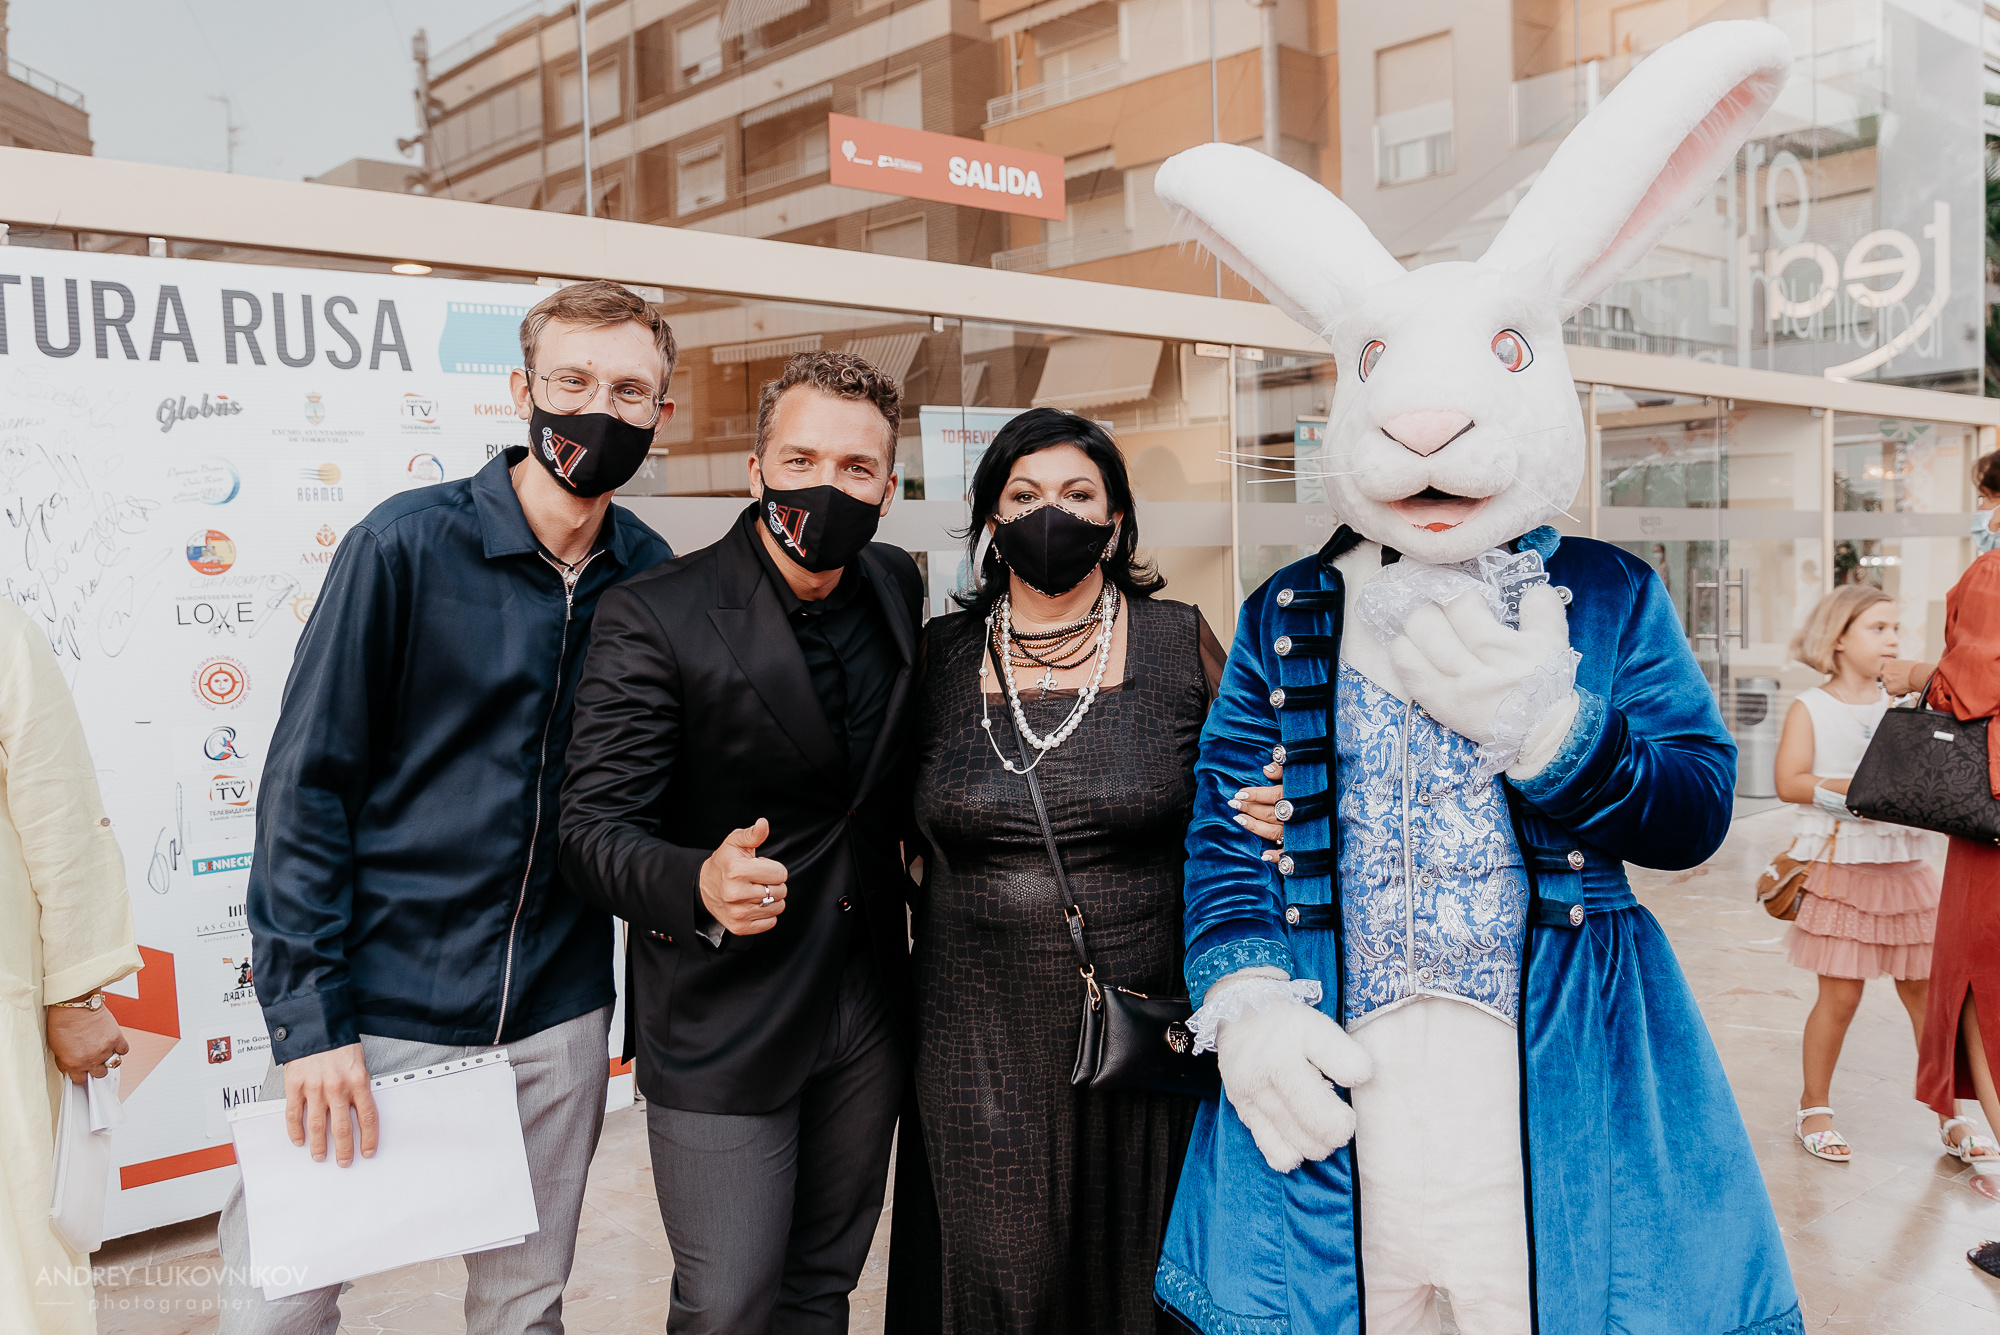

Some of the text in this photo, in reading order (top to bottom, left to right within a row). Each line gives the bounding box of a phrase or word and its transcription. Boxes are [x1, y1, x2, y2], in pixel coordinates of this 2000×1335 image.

[949, 156, 1043, 199] SALIDA
[221, 289, 412, 372] RUSA
[407, 405, 432, 417] TV
[474, 403, 517, 416] КИНО
[298, 487, 344, 502] AGAMED
[216, 786, 246, 800] TV
[197, 924, 216, 933] LAS
[223, 989, 245, 1003] ДЯДЯ
